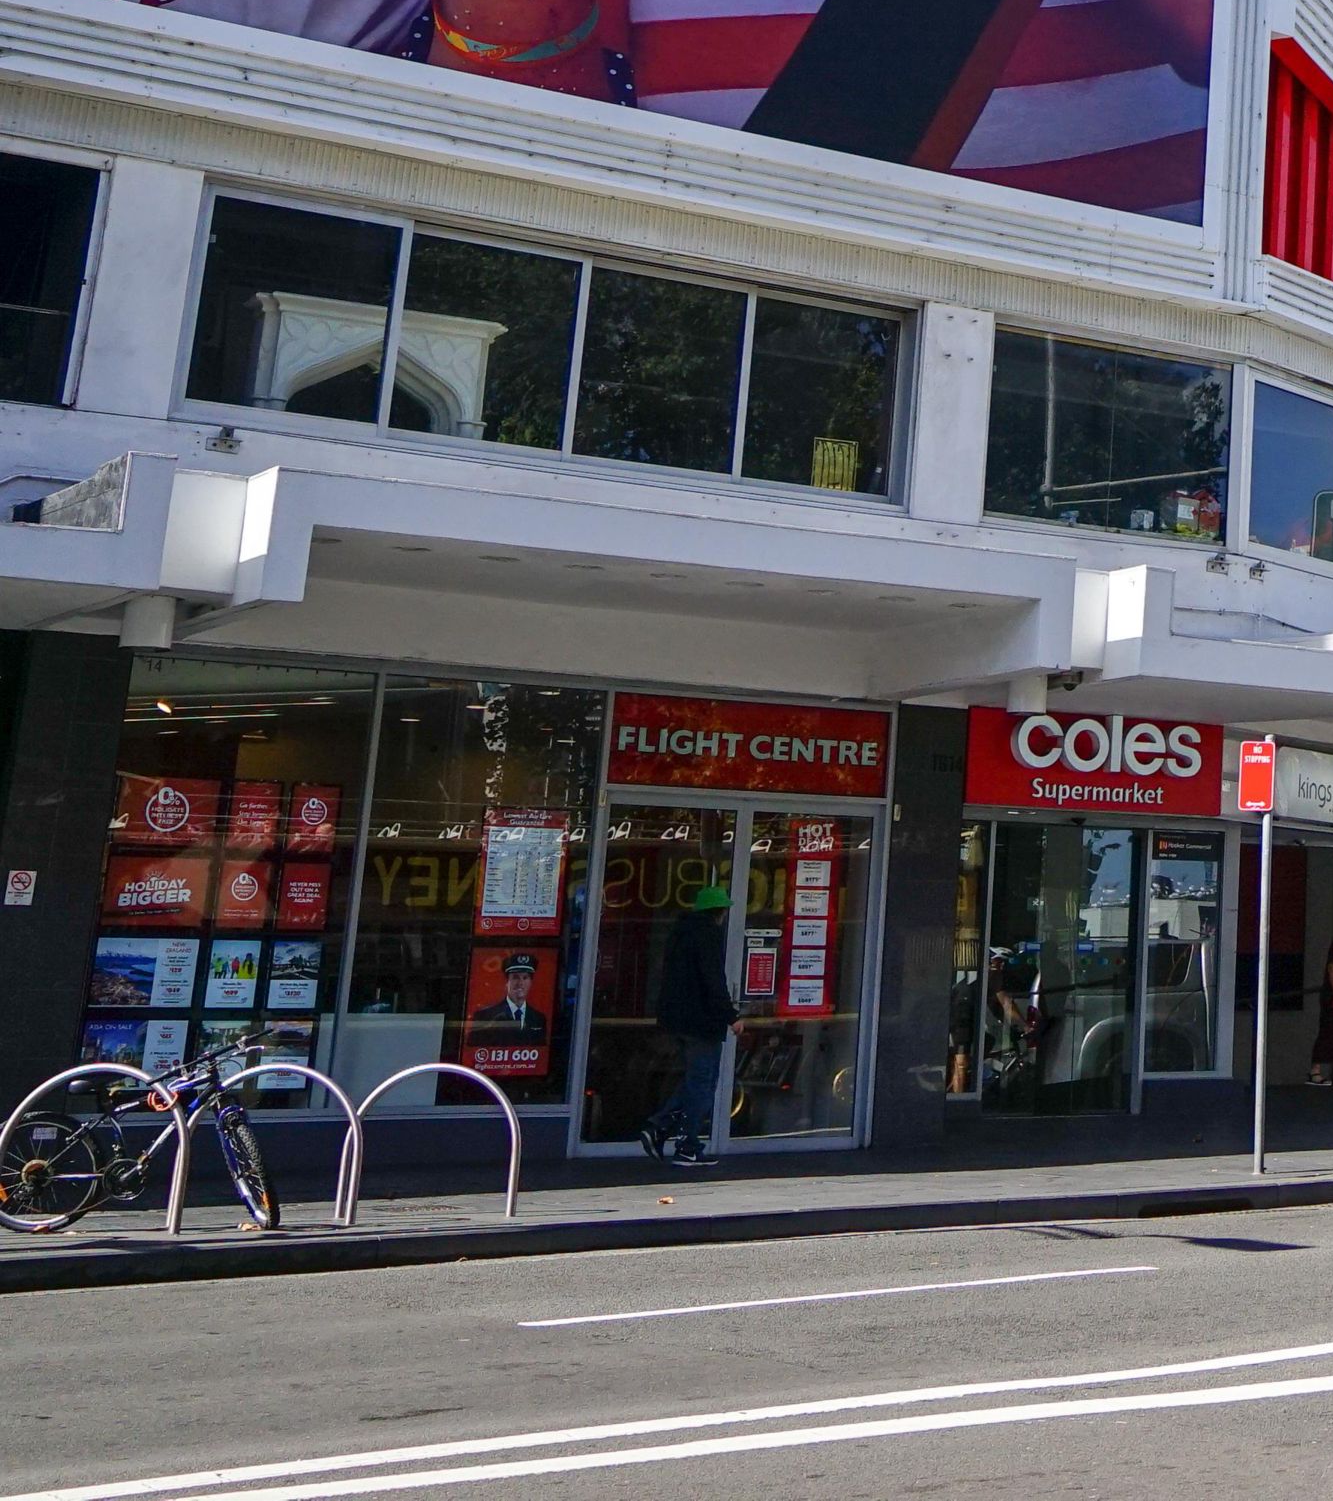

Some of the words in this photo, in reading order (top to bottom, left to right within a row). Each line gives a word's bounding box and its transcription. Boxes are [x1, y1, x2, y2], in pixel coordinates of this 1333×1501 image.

[618, 726, 744, 757] FLIGHT
[749, 735, 878, 766] CENTRE
[1014, 714, 1202, 778] coles
[1253, 746, 1262, 754] NO
[1244, 755, 1271, 764] STOPPING
[1031, 777, 1164, 806] Supermarket
[1298, 774, 1332, 808] kings
[799, 823, 834, 837] HOT
[125, 877, 187, 893] HOLIDAY
[117, 888, 192, 907] BIGGER
[491, 1050, 508, 1061] 131
[512, 1049, 539, 1061] 600
